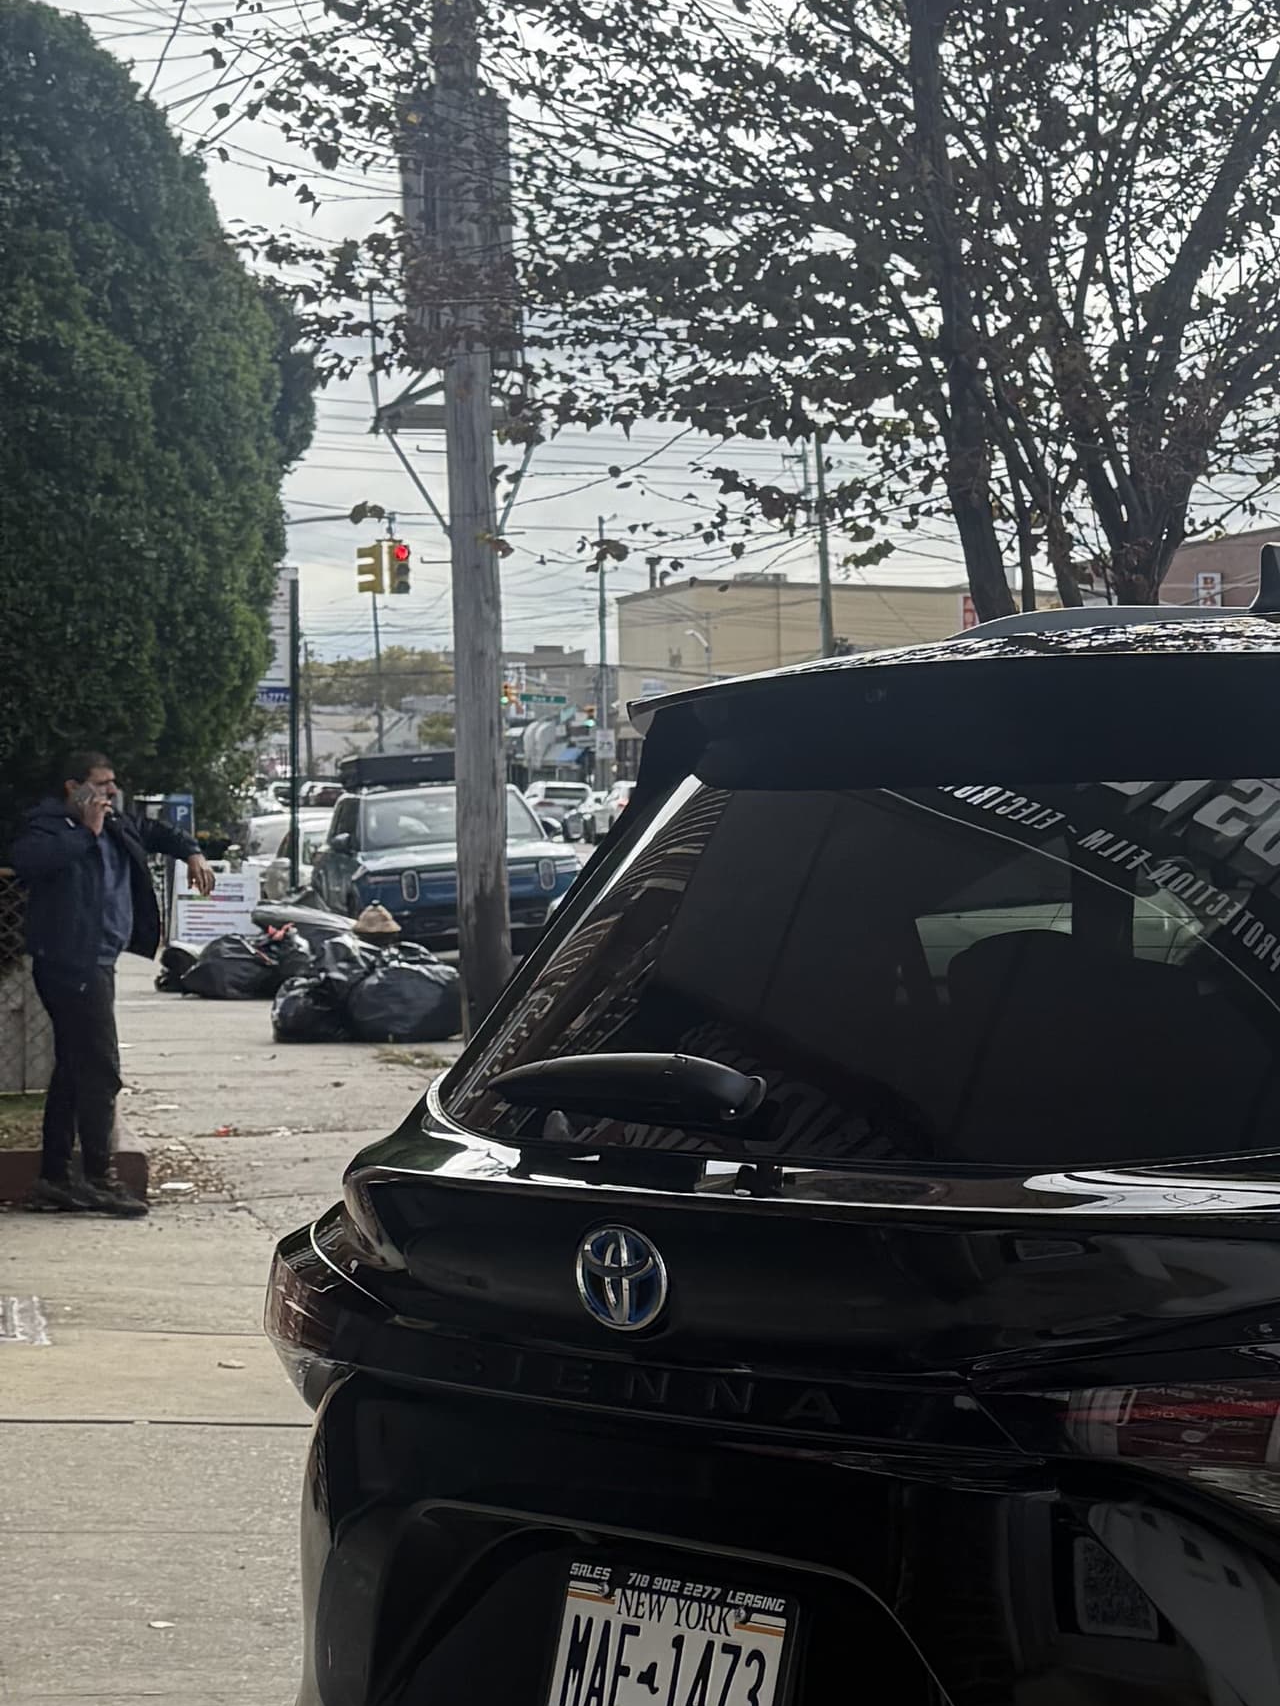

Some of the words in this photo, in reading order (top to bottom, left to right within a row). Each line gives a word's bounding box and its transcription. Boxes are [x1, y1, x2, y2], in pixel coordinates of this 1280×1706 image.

[569, 1562, 612, 1581] SALES
[627, 1572, 651, 1588] 718
[652, 1577, 682, 1593] 902
[683, 1582, 722, 1601] 2277
[726, 1589, 787, 1613] LEASING
[616, 1589, 667, 1624] NEW
[670, 1597, 734, 1637] YORK
